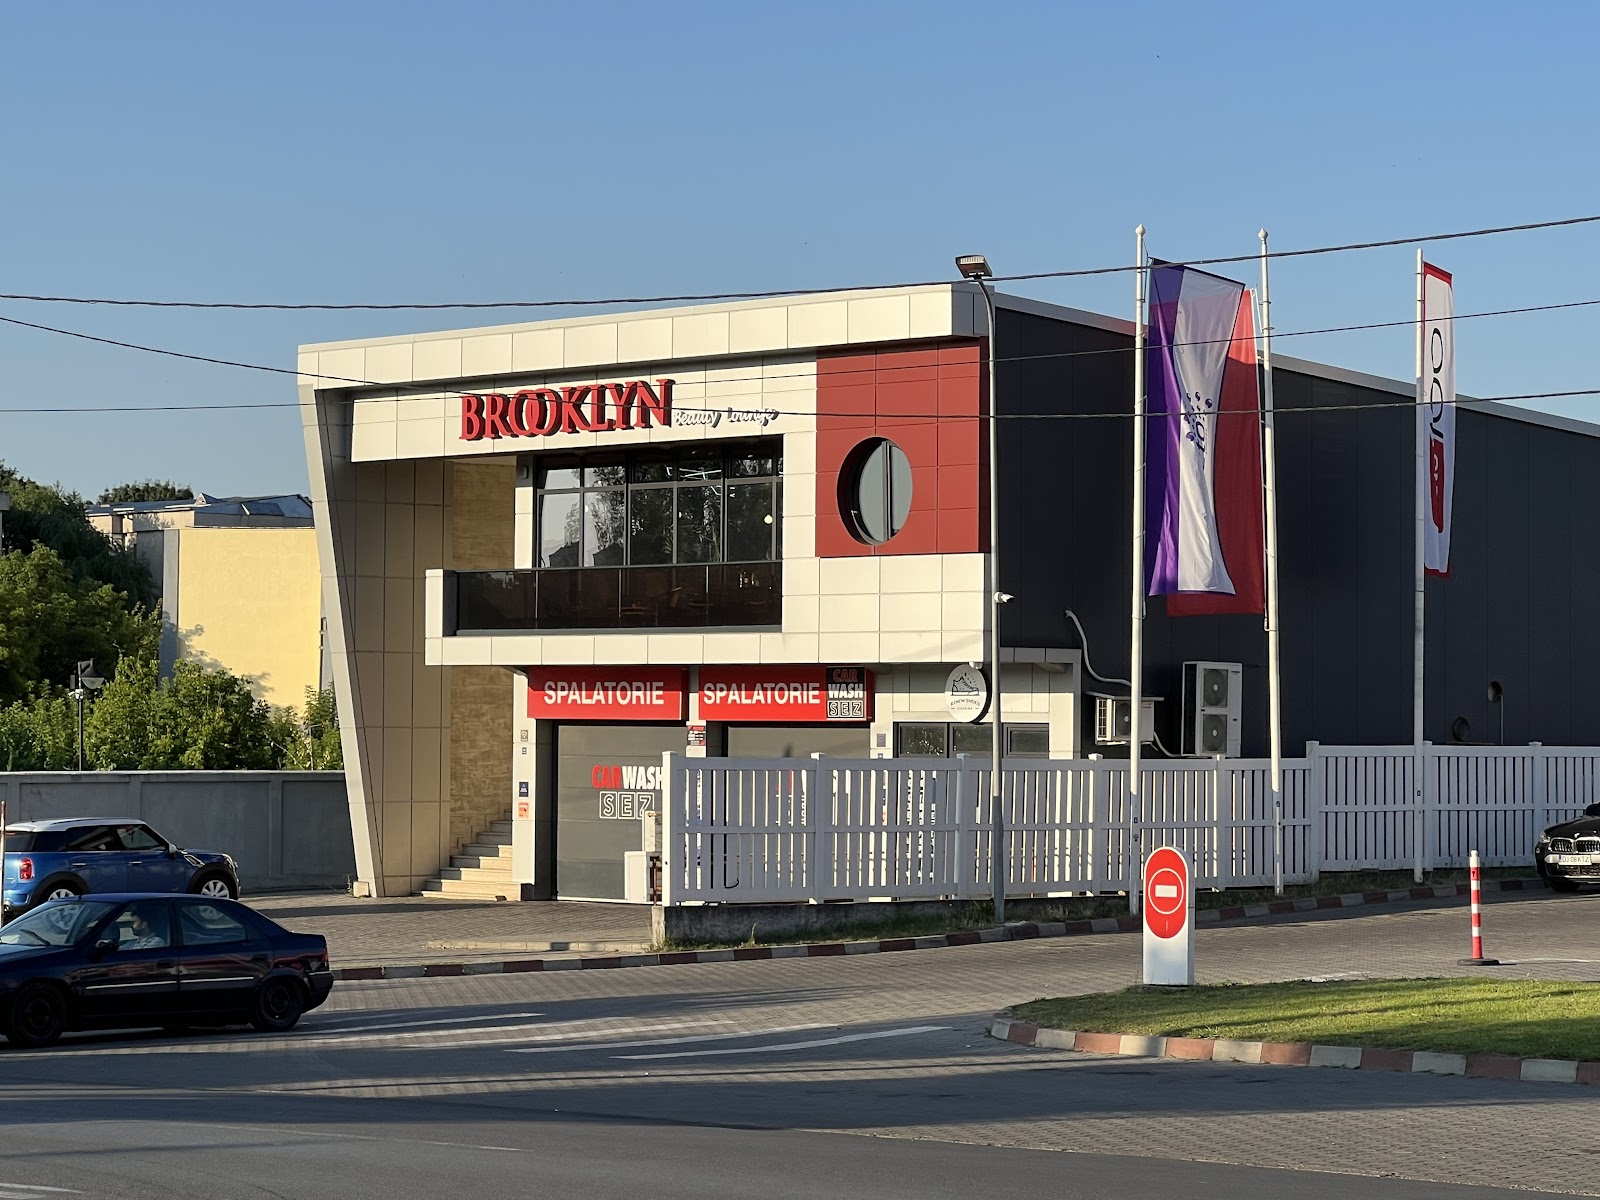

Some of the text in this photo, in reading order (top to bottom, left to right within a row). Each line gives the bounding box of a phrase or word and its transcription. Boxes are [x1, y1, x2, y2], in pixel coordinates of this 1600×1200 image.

[459, 379, 674, 441] BROOKLYN
[833, 668, 858, 682] CAR
[543, 680, 665, 705] SPALATORIE
[703, 682, 821, 704] SPALATORIE
[828, 683, 863, 698] WASH
[829, 701, 862, 716] SEZ
[602, 793, 652, 818] SEZ
